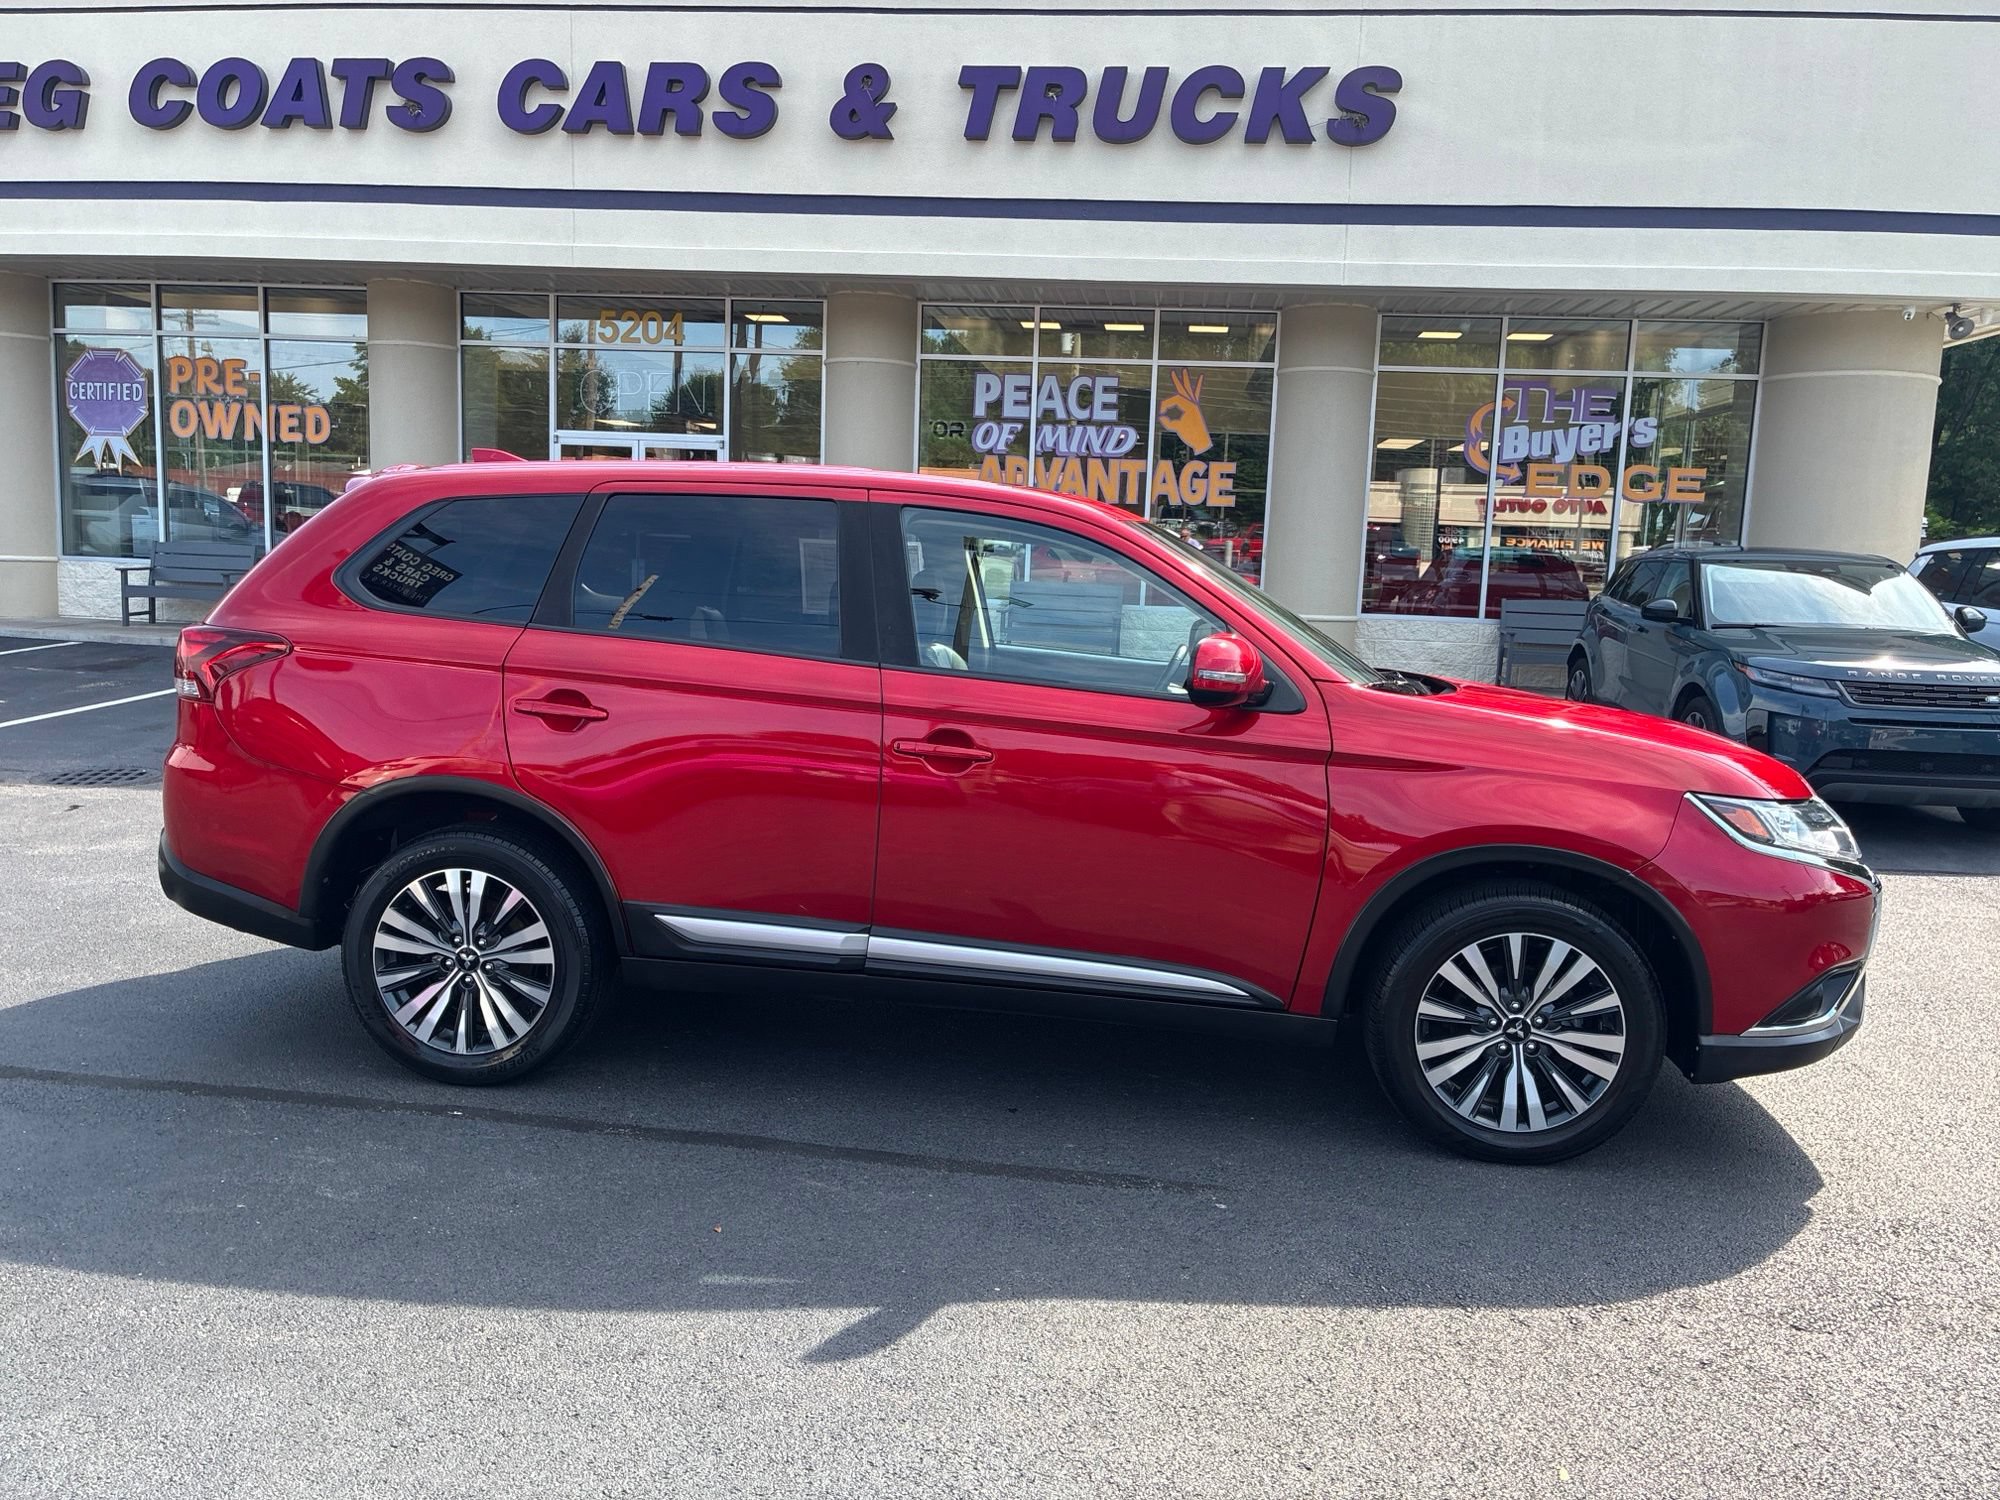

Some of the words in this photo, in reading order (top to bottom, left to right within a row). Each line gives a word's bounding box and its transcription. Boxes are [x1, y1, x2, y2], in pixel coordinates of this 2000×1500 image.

[128, 57, 456, 133] COATS
[497, 58, 783, 139] CARS
[829, 62, 898, 140] &
[957, 64, 1403, 147] TRUCKS
[598, 309, 685, 345] 5204
[69, 382, 143, 402] CERTIFIED
[168, 355, 260, 397] PRE-
[580, 369, 706, 415] OPEN
[972, 372, 1120, 422] PEACE
[169, 400, 331, 444] OWNED
[1503, 379, 1618, 425] THE
[972, 421, 1022, 454] OF
[1036, 423, 1139, 457] MIND
[978, 455, 1237, 508] ADVANTAGE
[1524, 462, 1708, 503] EDGE
[1847, 670, 1922, 680] RANGE
